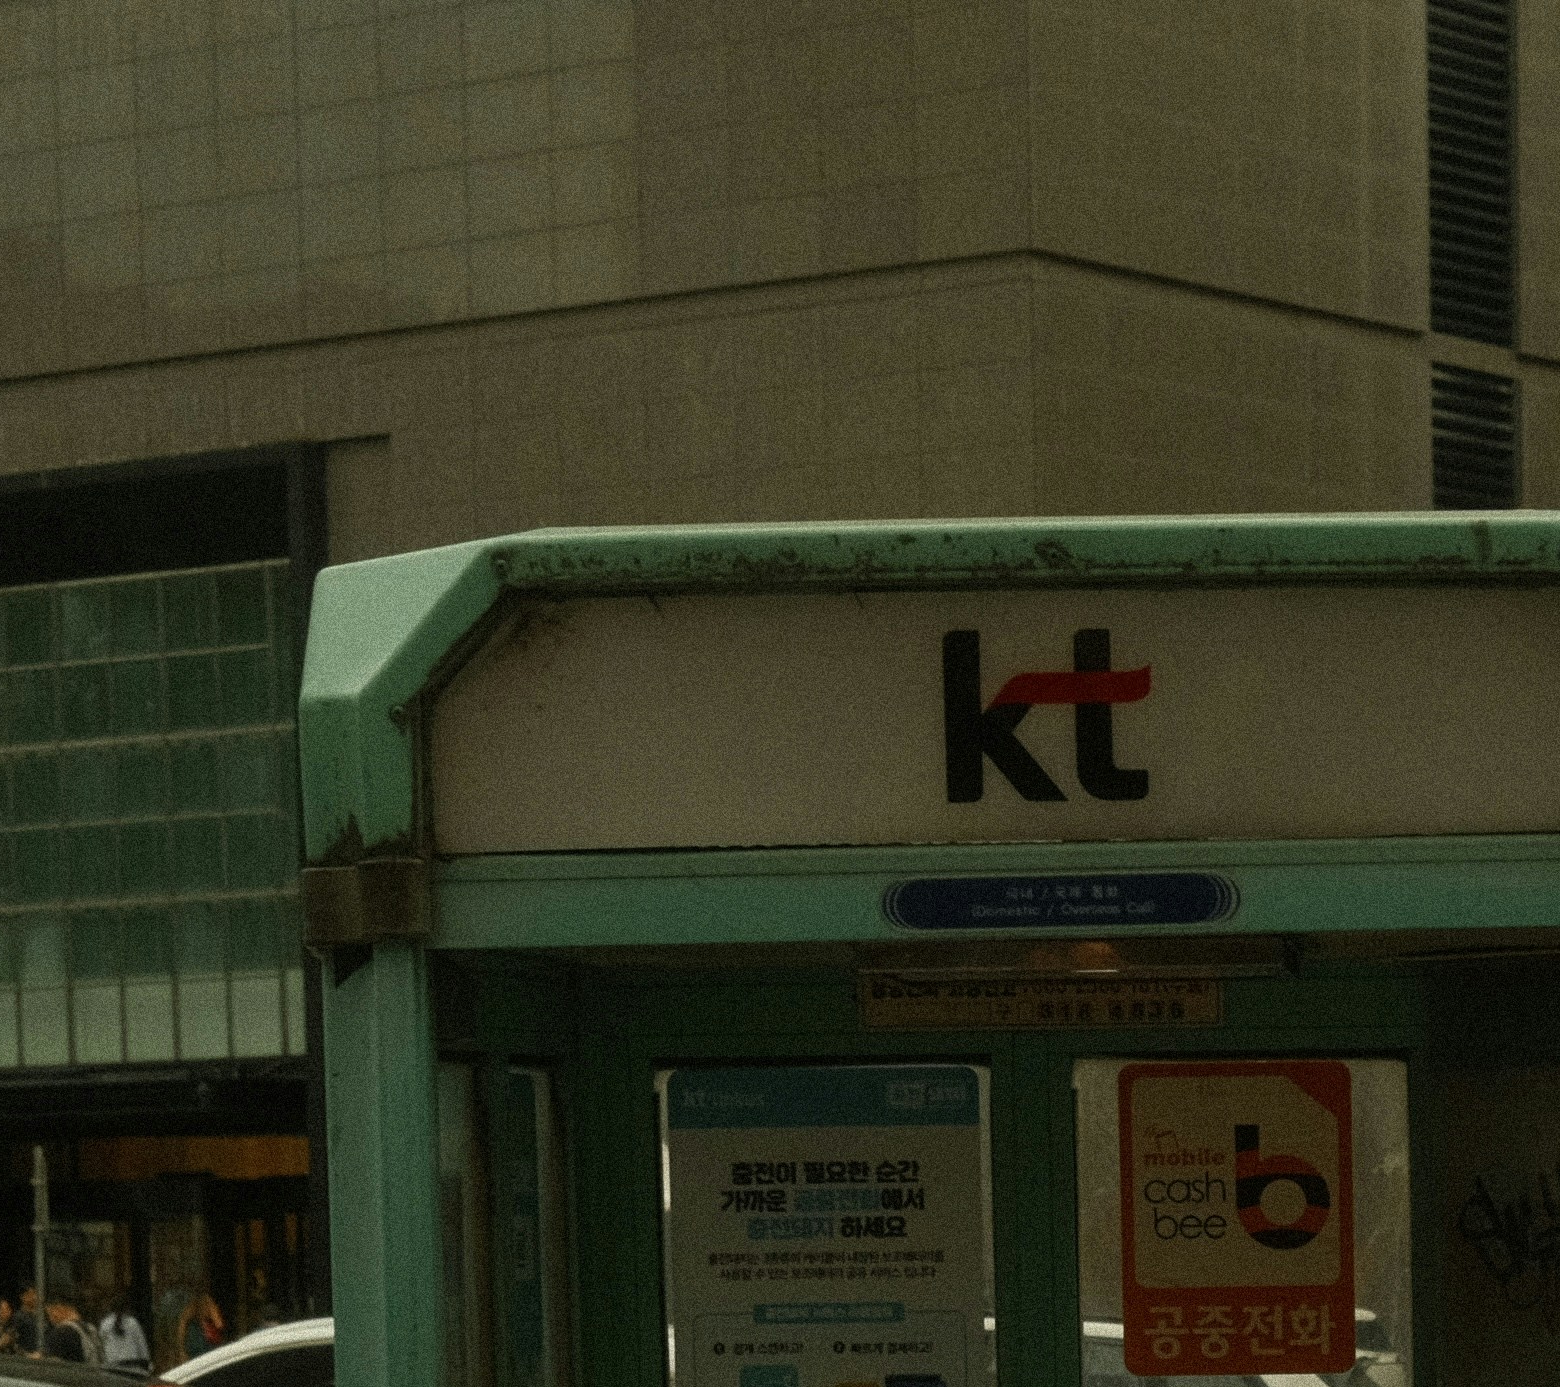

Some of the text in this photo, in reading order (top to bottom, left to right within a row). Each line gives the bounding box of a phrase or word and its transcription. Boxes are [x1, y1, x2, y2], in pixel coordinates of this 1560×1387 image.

[941, 627, 1151, 804] kt
[1055, 885, 1082, 900] 국제
[1091, 885, 1119, 899] 통화
[1061, 903, 1121, 916] Overseas
[1144, 1147, 1226, 1167] mobile
[731, 1161, 920, 1186] 충전이 필요한 순간
[1143, 1171, 1227, 1205] cash
[720, 1189, 787, 1213] 가까운
[840, 1216, 907, 1238] 하세요
[1153, 1208, 1228, 1240] bee
[1144, 1304, 1336, 1360] 공중전화
